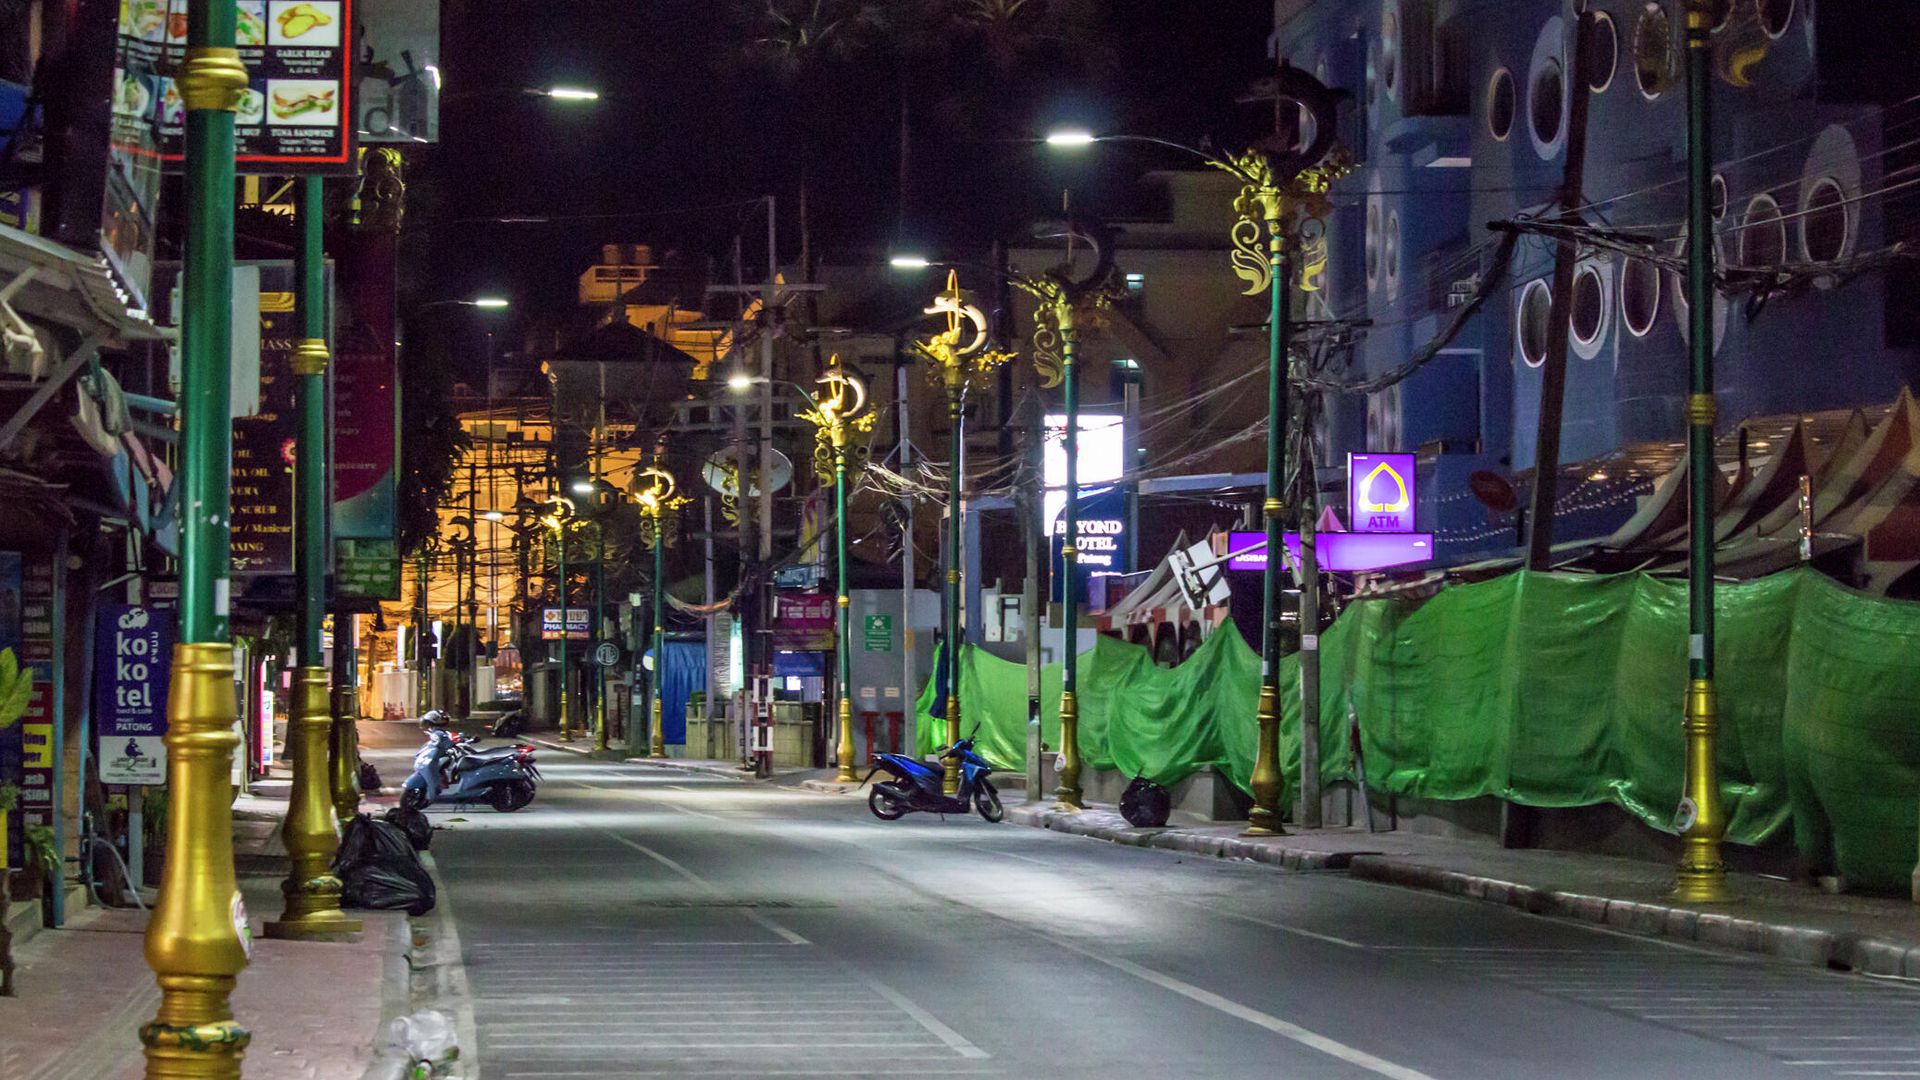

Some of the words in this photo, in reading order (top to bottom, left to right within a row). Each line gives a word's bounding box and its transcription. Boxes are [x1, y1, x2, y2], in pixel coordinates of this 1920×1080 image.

[272, 129, 292, 137] TUNA
[1056, 520, 1122, 534] BYOND
[1368, 516, 1399, 528] ATM
[1063, 537, 1117, 550] OTEL
[117, 631, 148, 655] ko
[117, 657, 148, 680] ko
[116, 683, 152, 706] tel
[116, 723, 152, 731] PATONG
